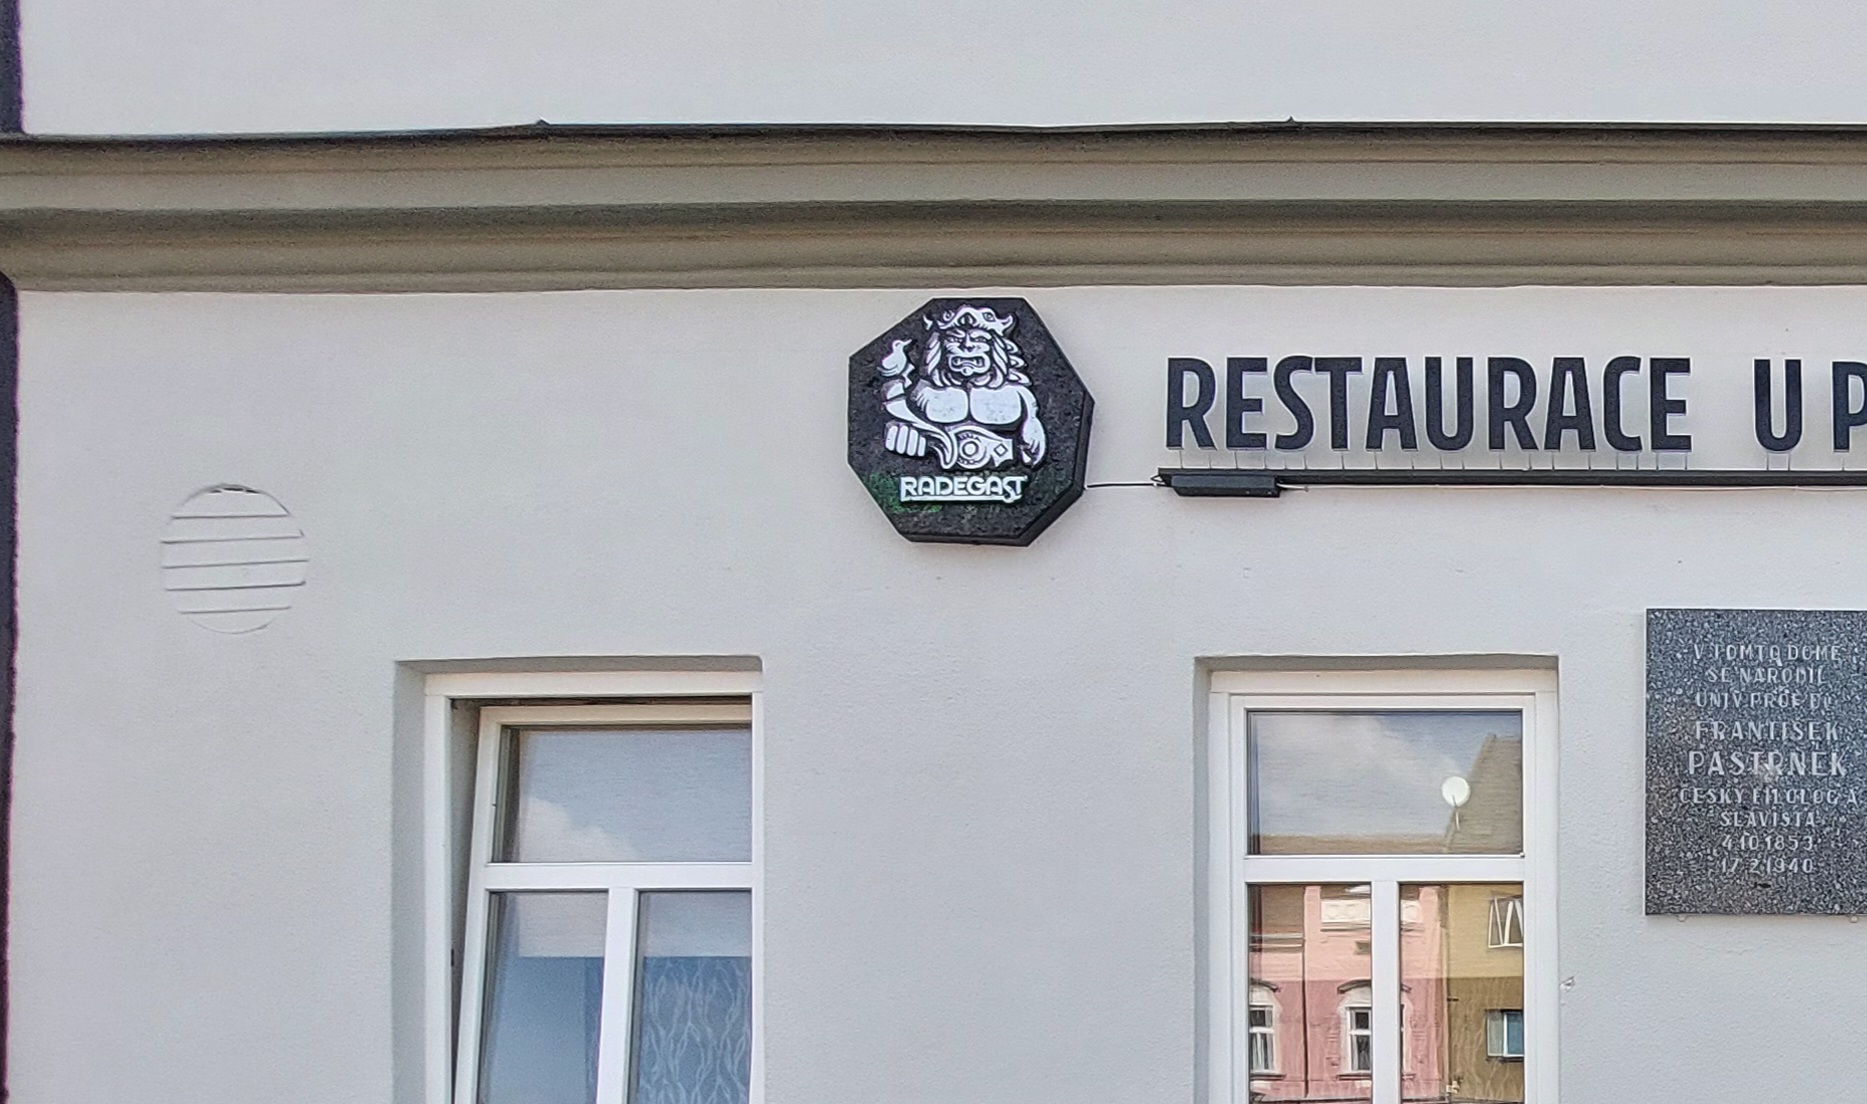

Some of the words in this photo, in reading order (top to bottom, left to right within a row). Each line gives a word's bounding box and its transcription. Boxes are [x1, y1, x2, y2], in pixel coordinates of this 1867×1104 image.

[1166, 355, 1692, 453] RESTAURACE
[1753, 357, 1802, 452] U
[901, 475, 1027, 503] RADEGAST
[1707, 667, 1732, 684] SE
[1740, 667, 1825, 684] NARODIL
[1688, 750, 1846, 776] PASTRNEK
[1753, 787, 1838, 805] FILOLOG
[1720, 811, 1816, 827] SLAVISTA
